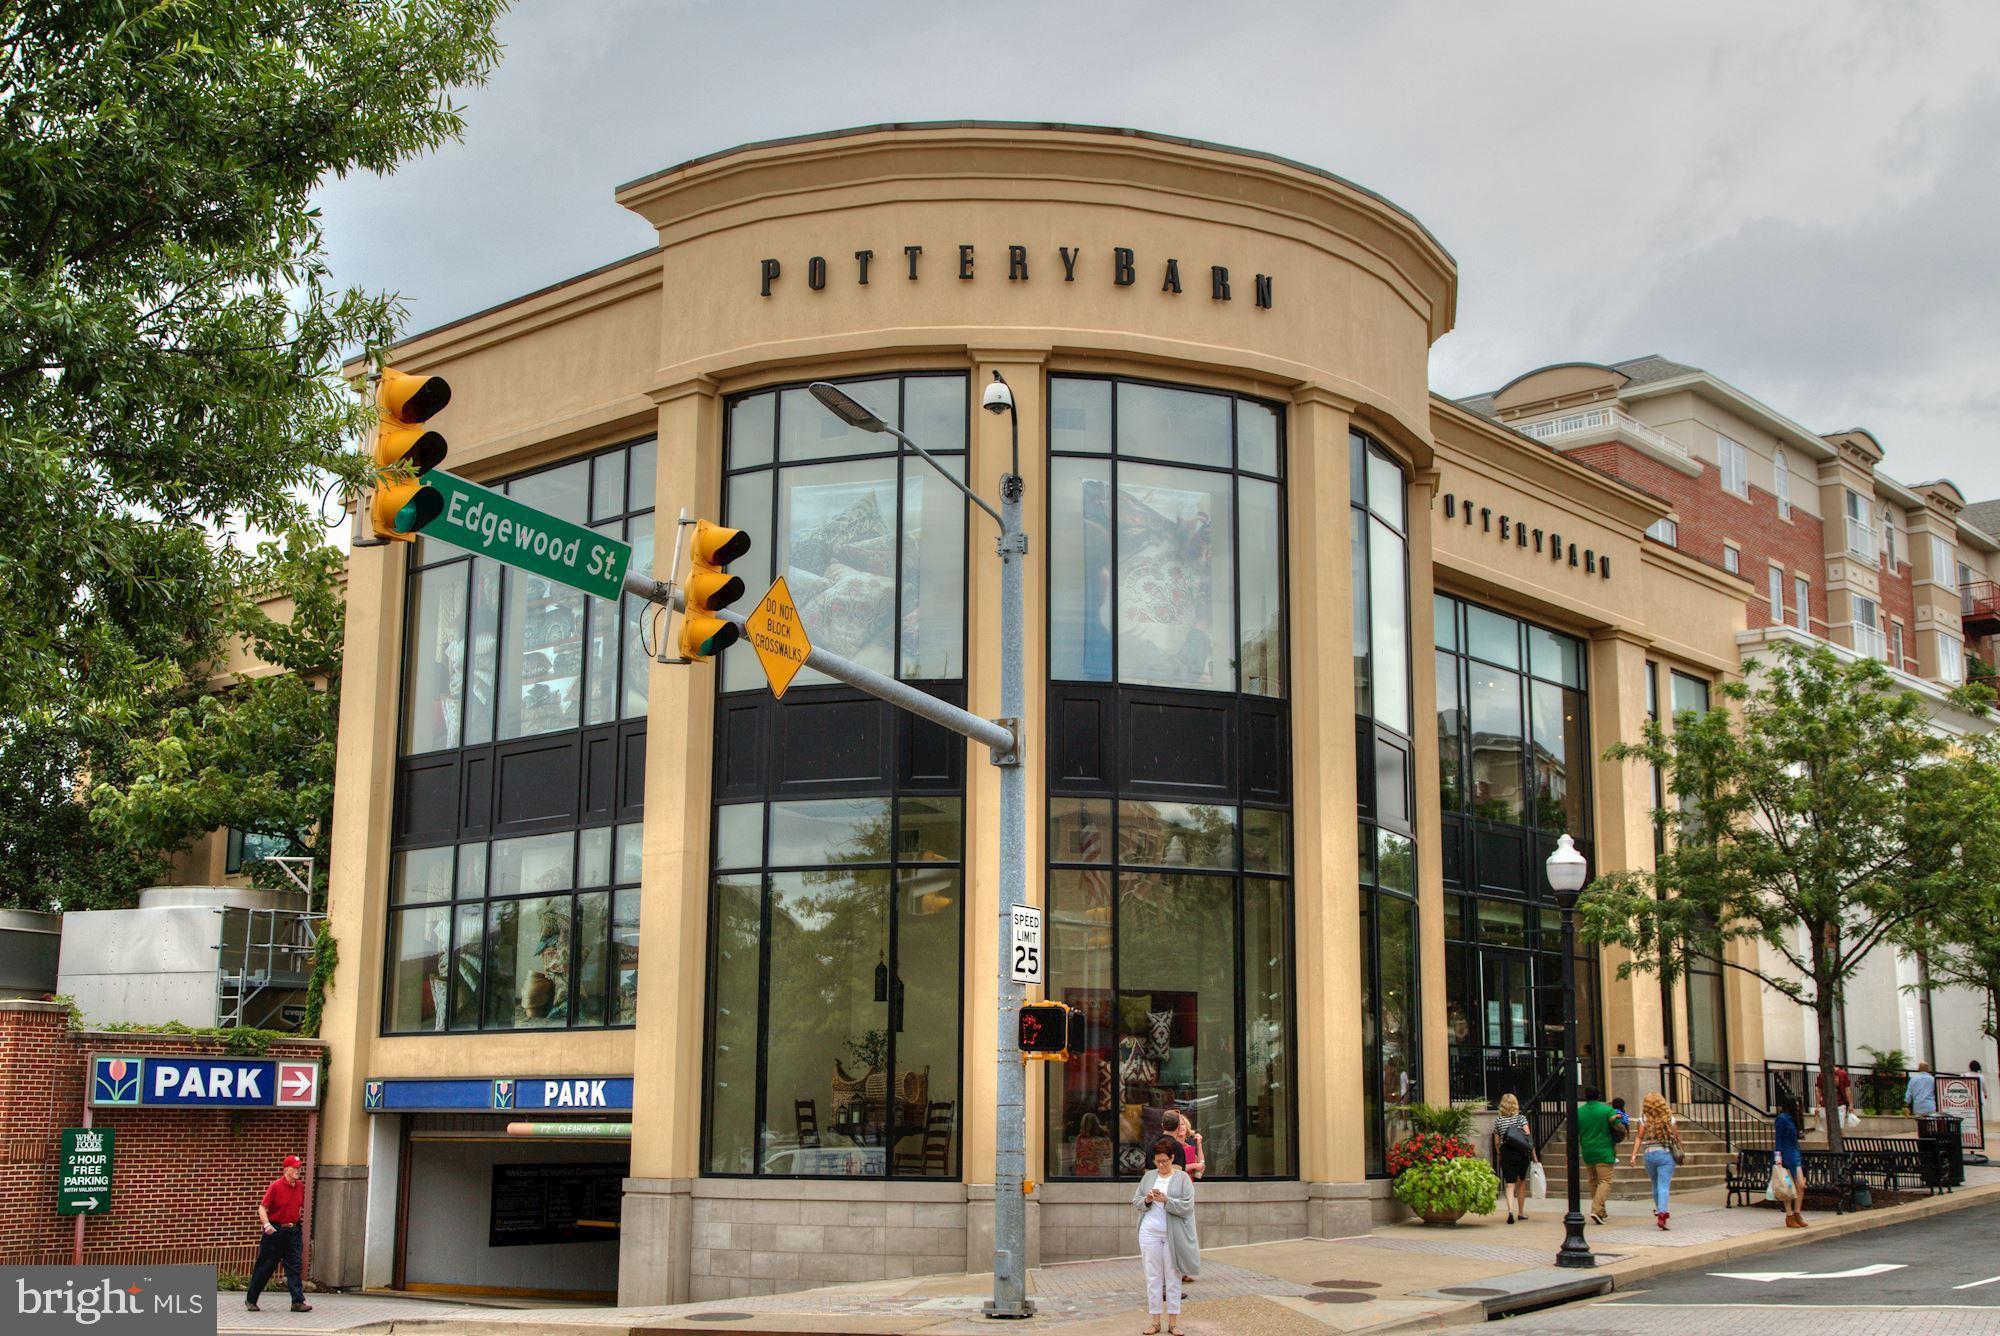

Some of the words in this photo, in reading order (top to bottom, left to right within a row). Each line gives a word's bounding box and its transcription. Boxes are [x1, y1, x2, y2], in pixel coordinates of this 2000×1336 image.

[446, 490, 581, 568] Edgewood
[586, 544, 618, 583] St.
[766, 598, 777, 615] DO
[779, 603, 794, 621] NOT
[767, 618, 791, 639] BLOCK
[755, 633, 802, 662] CROSSWALKS
[1014, 913, 1040, 928] SPEED
[1016, 930, 1037, 943] LIMIT
[1015, 945, 1039, 975] 25
[155, 1066, 262, 1099] PARK
[544, 1080, 607, 1106] PARK
[75, 1133, 104, 1142] WHOLE
[558, 1124, 601, 1134] CLEARANCE
[68, 1155, 76, 1164] 2
[77, 1155, 107, 1165] HOUR
[73, 1166, 102, 1175] FREE
[64, 1176, 109, 1186] PARKING
